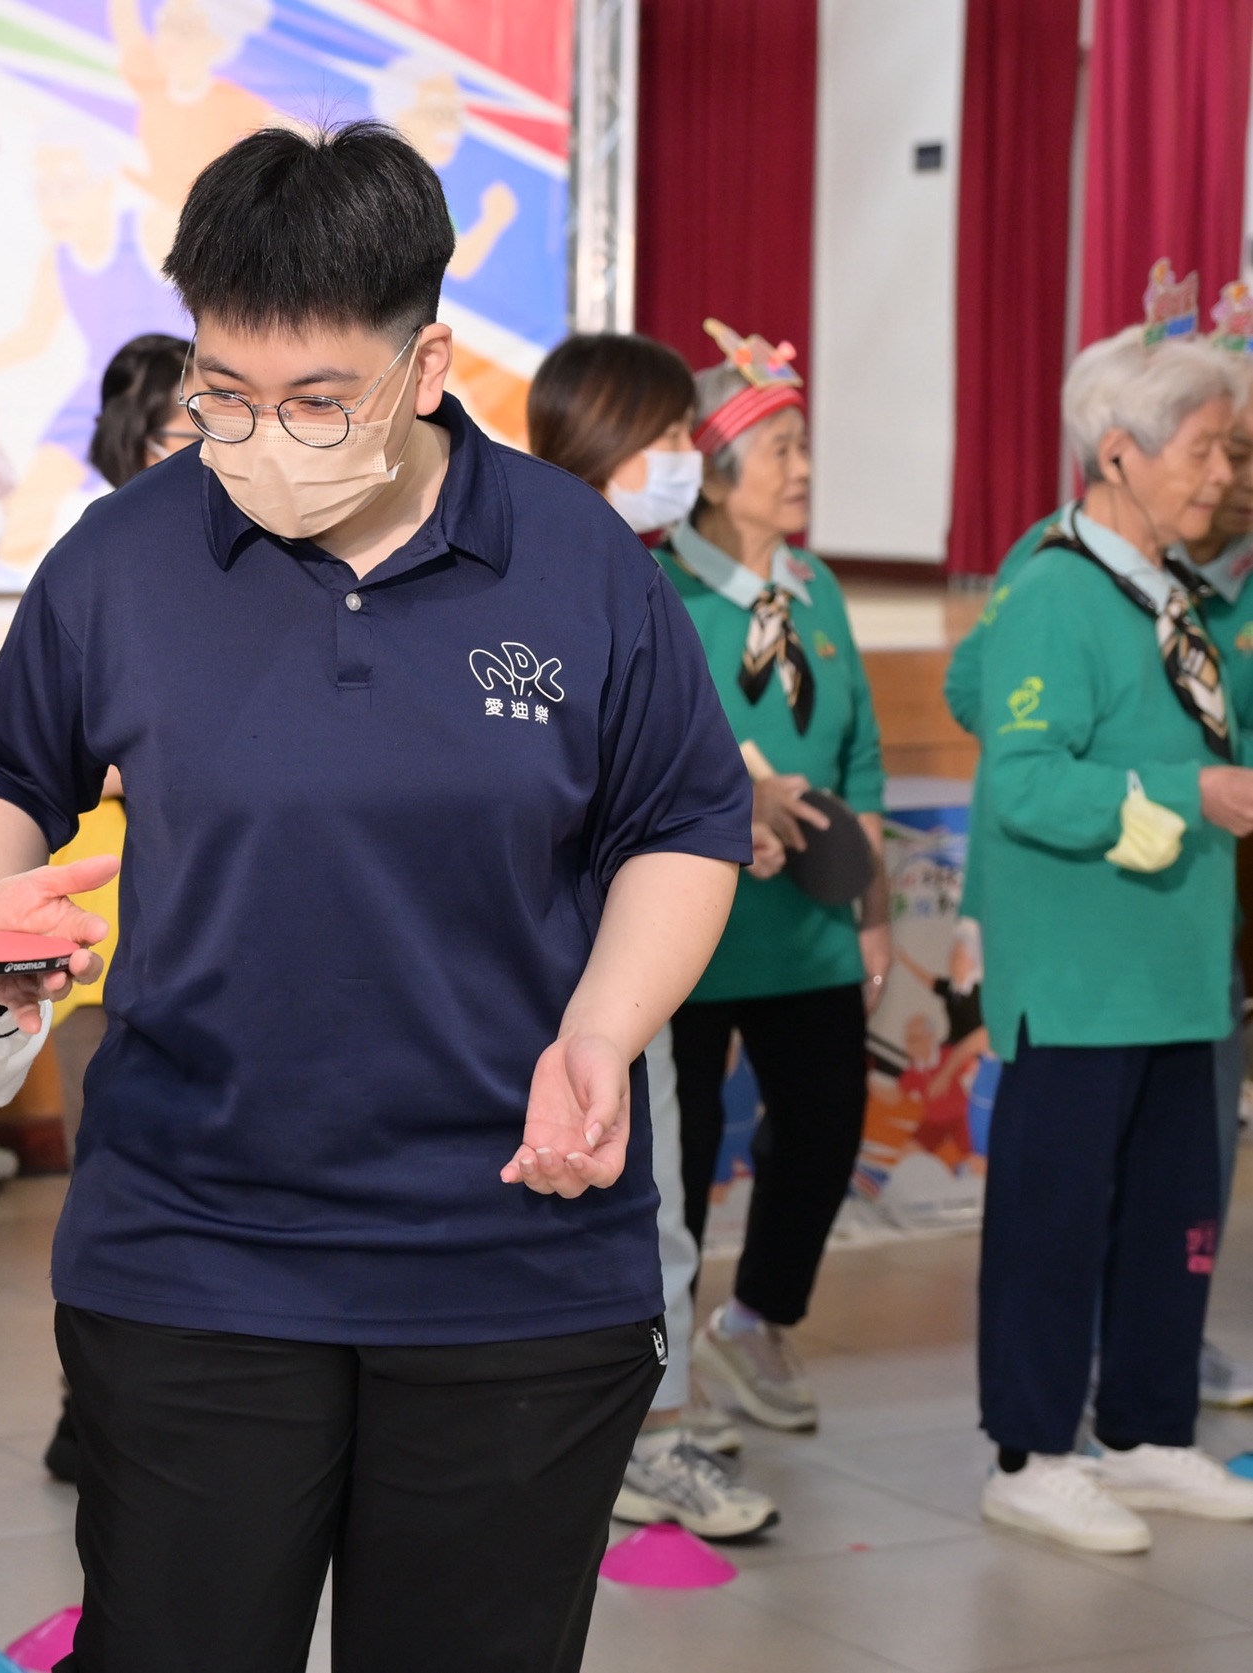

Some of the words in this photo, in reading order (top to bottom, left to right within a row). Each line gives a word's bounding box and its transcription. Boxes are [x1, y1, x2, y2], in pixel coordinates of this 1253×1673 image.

[484, 697, 549, 725] 愛迪樂
[13, 961, 47, 971] DECATHLON
